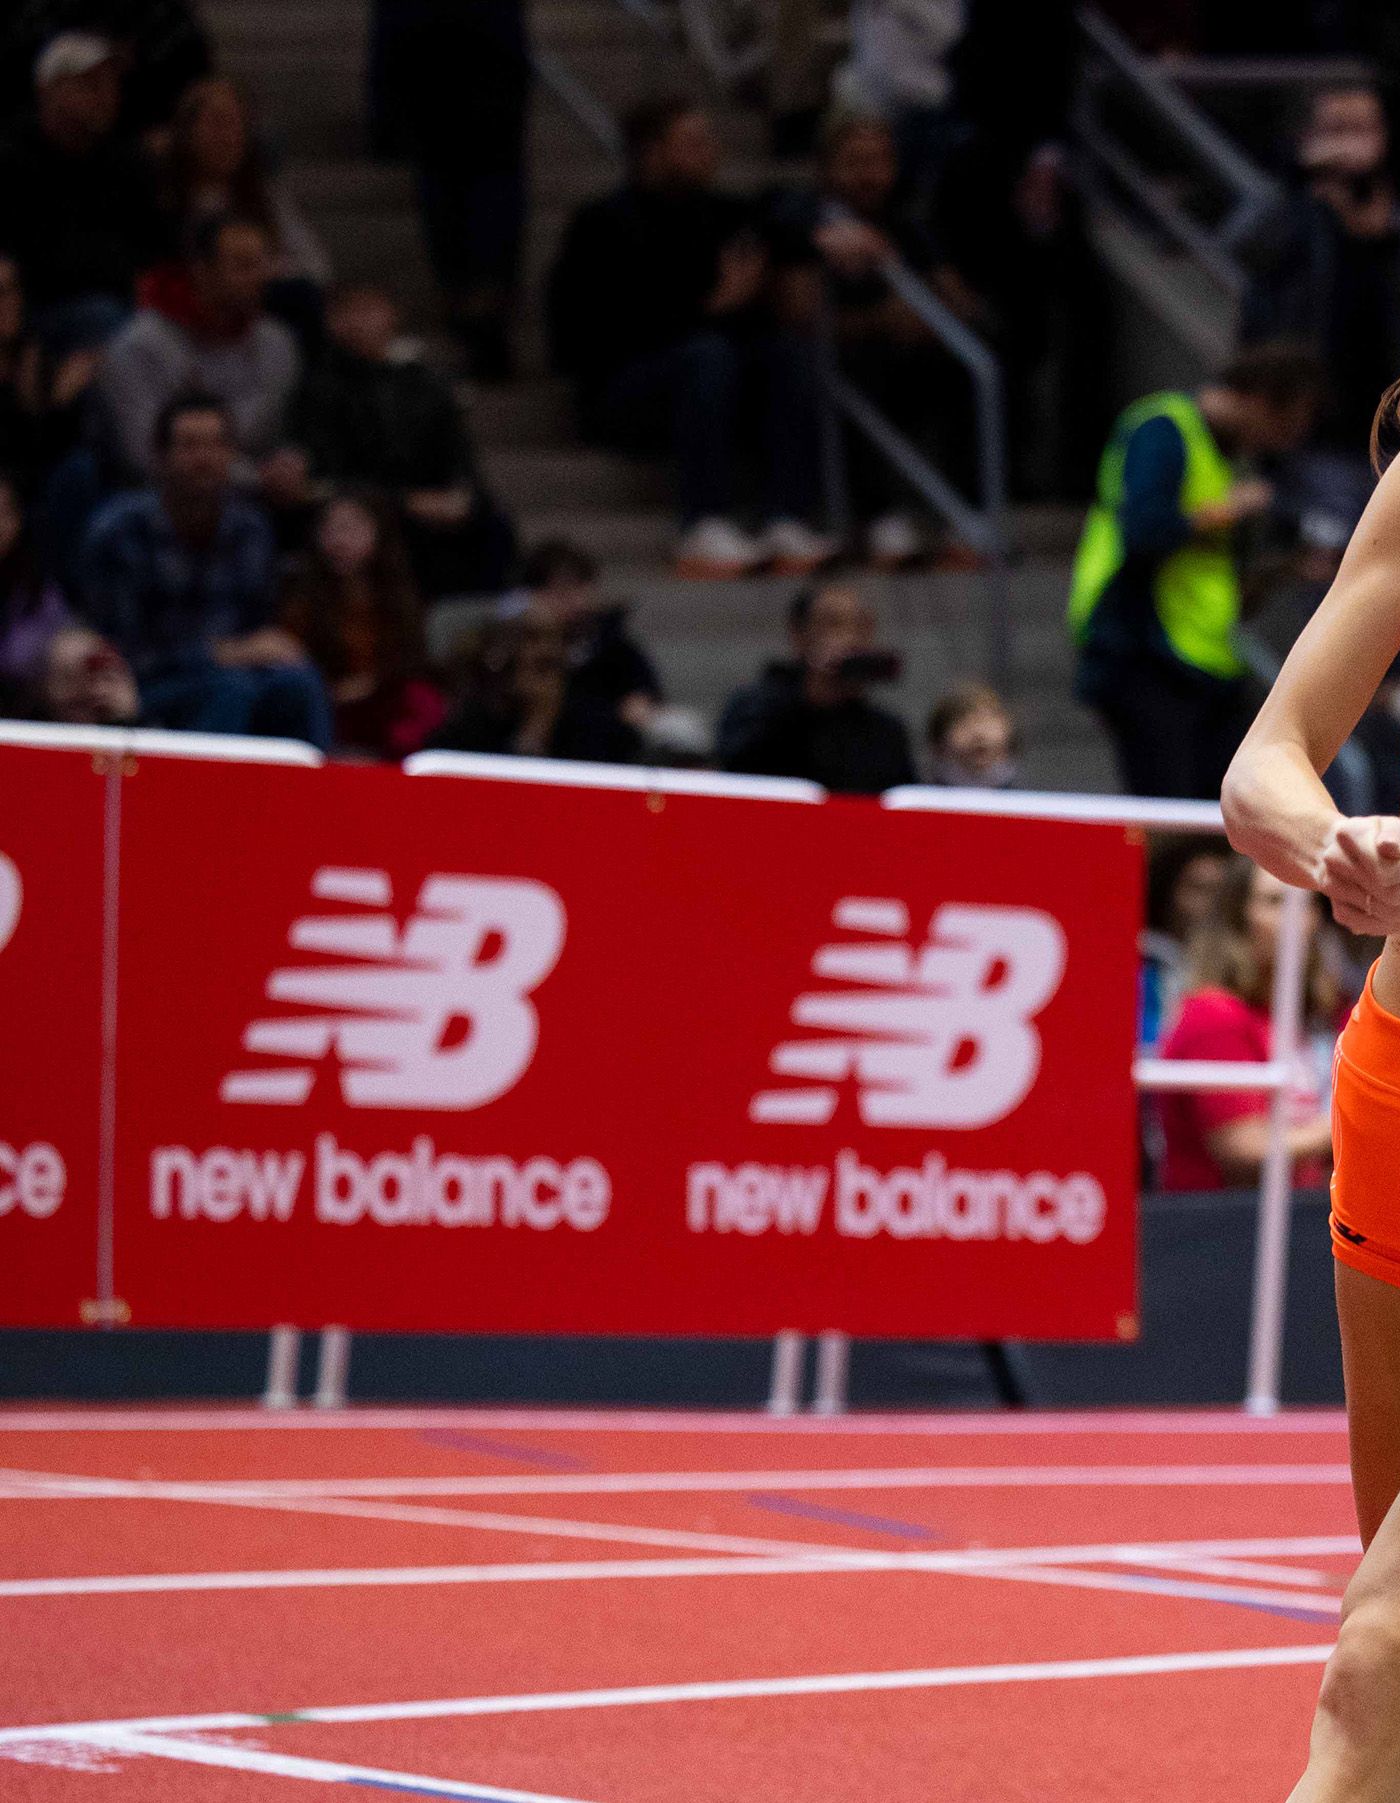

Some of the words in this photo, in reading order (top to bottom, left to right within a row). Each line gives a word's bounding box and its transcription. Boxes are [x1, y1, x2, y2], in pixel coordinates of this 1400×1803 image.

[221, 867, 566, 1110] NB
[751, 897, 1066, 1130] NB
[151, 1145, 304, 1220] new
[316, 1134, 611, 1231] balance
[687, 1162, 828, 1234] new
[835, 1150, 1106, 1243] balance
